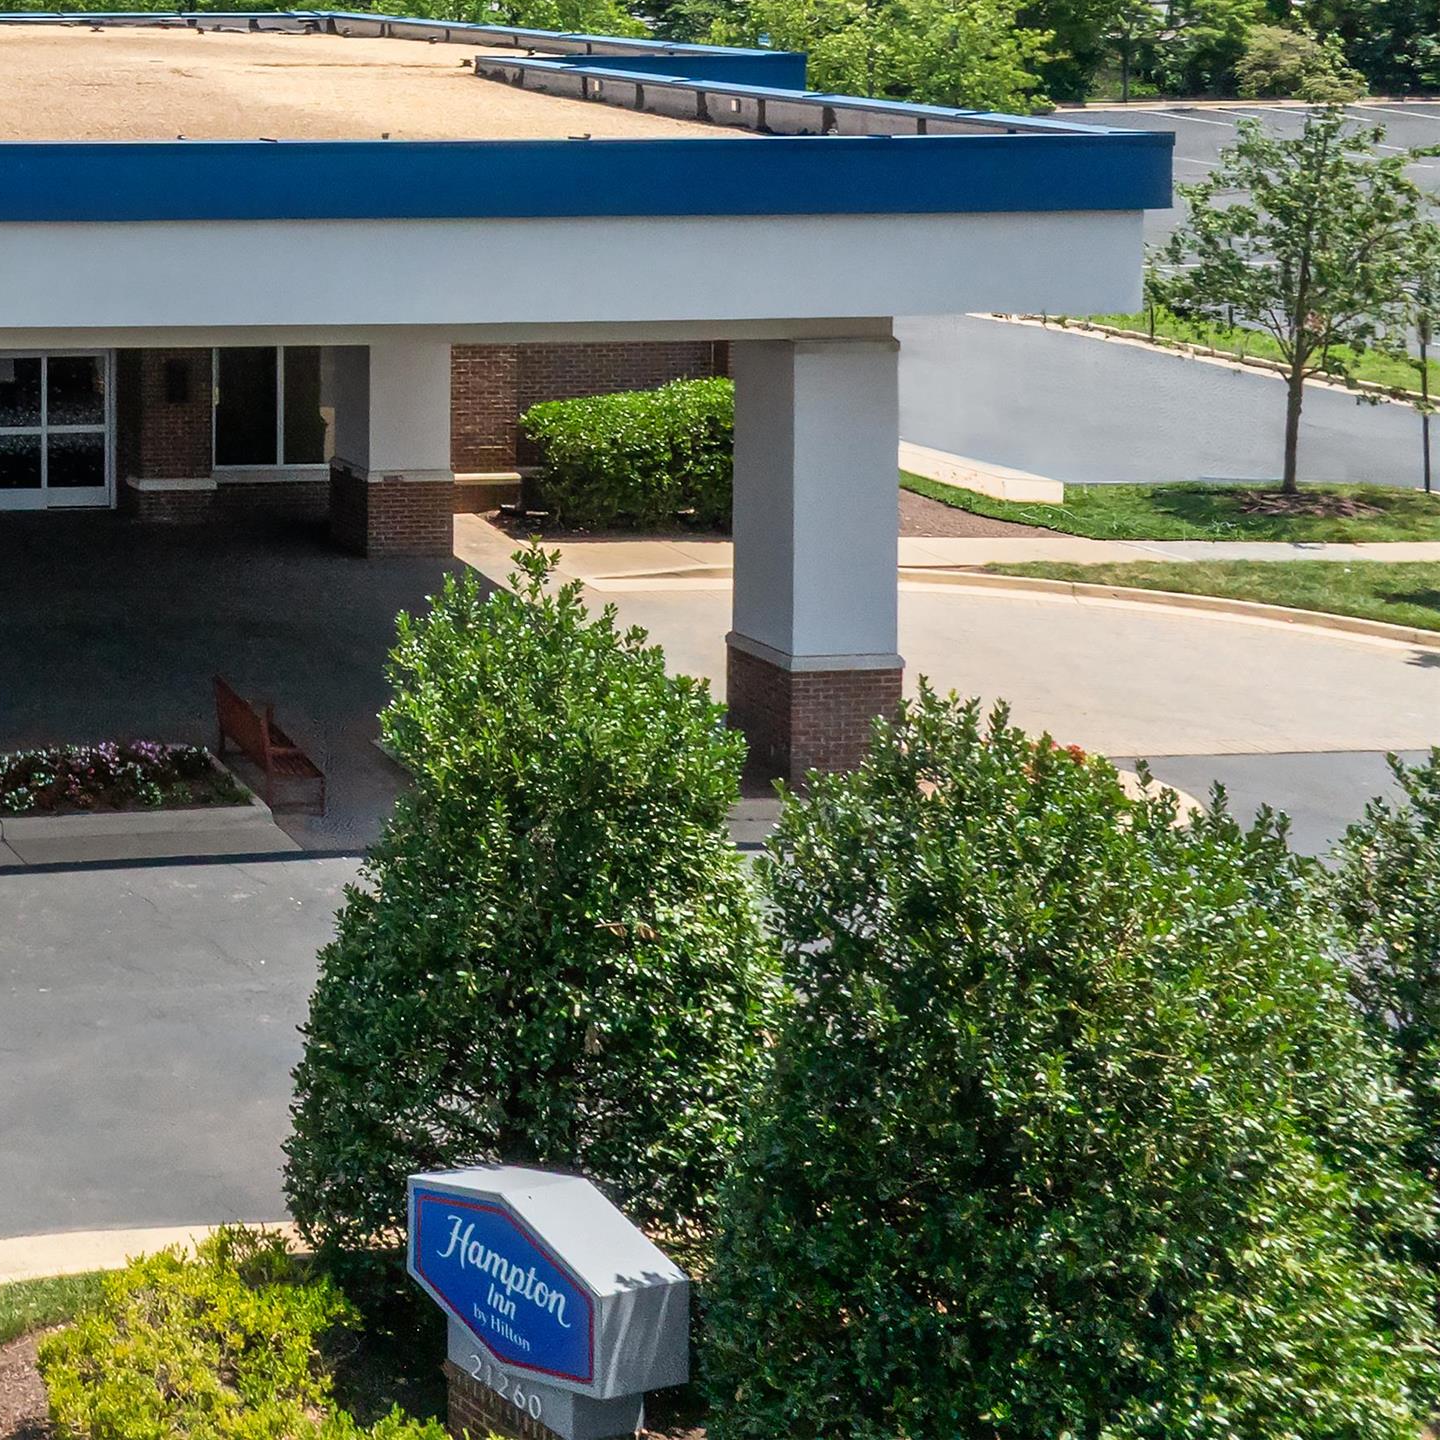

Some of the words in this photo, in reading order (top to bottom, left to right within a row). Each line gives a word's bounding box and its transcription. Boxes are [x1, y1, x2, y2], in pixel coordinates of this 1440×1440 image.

[437, 1215, 571, 1328] Hampton
[473, 1302, 487, 1326] by
[491, 1315, 531, 1352] Hilton
[487, 1282, 516, 1320] Inn
[470, 1354, 542, 1420] 21260
